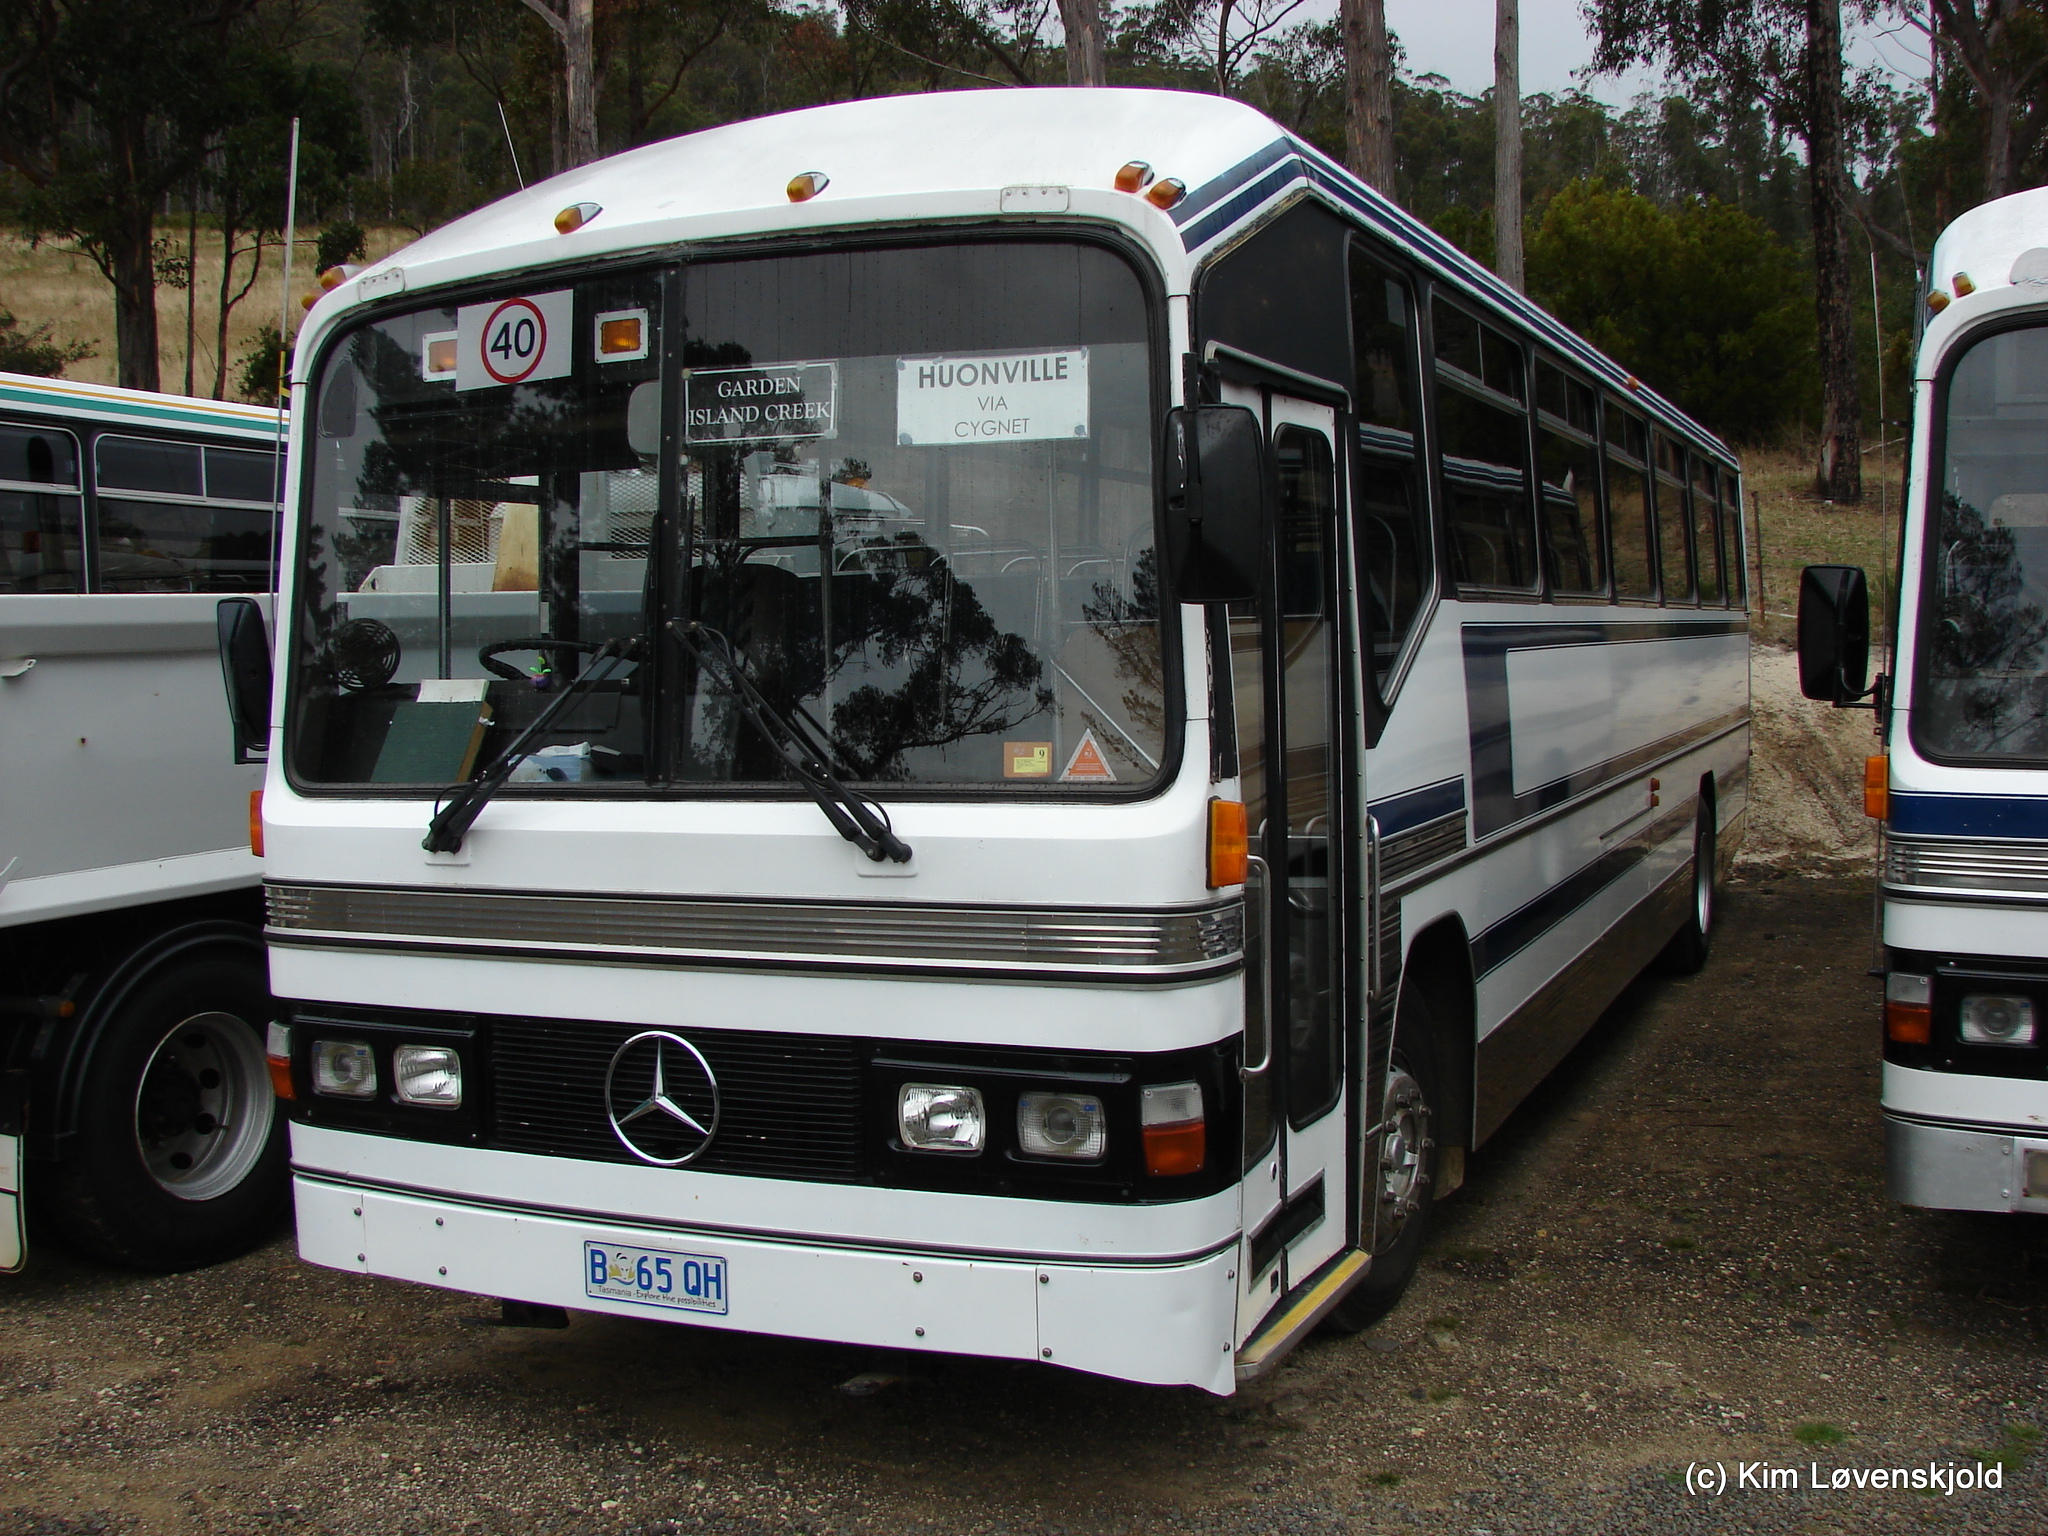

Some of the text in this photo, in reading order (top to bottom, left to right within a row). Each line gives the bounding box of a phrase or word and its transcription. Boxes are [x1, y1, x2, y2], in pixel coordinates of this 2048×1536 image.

[490, 318, 536, 360] 40
[918, 356, 1068, 388] HUONVILLE
[717, 376, 802, 398] GARDEN
[689, 400, 832, 426] ISLAND CREEK
[977, 395, 1008, 411] VIA
[954, 417, 1030, 437] CYGNET
[1038, 749, 1045, 758] 9
[590, 1249, 721, 1300] B 65 QH
[597, 1285, 632, 1297] Tasmania
[636, 1289, 661, 1301] Explore
[662, 1293, 676, 1303] the
[677, 1296, 716, 1309] possibilities
